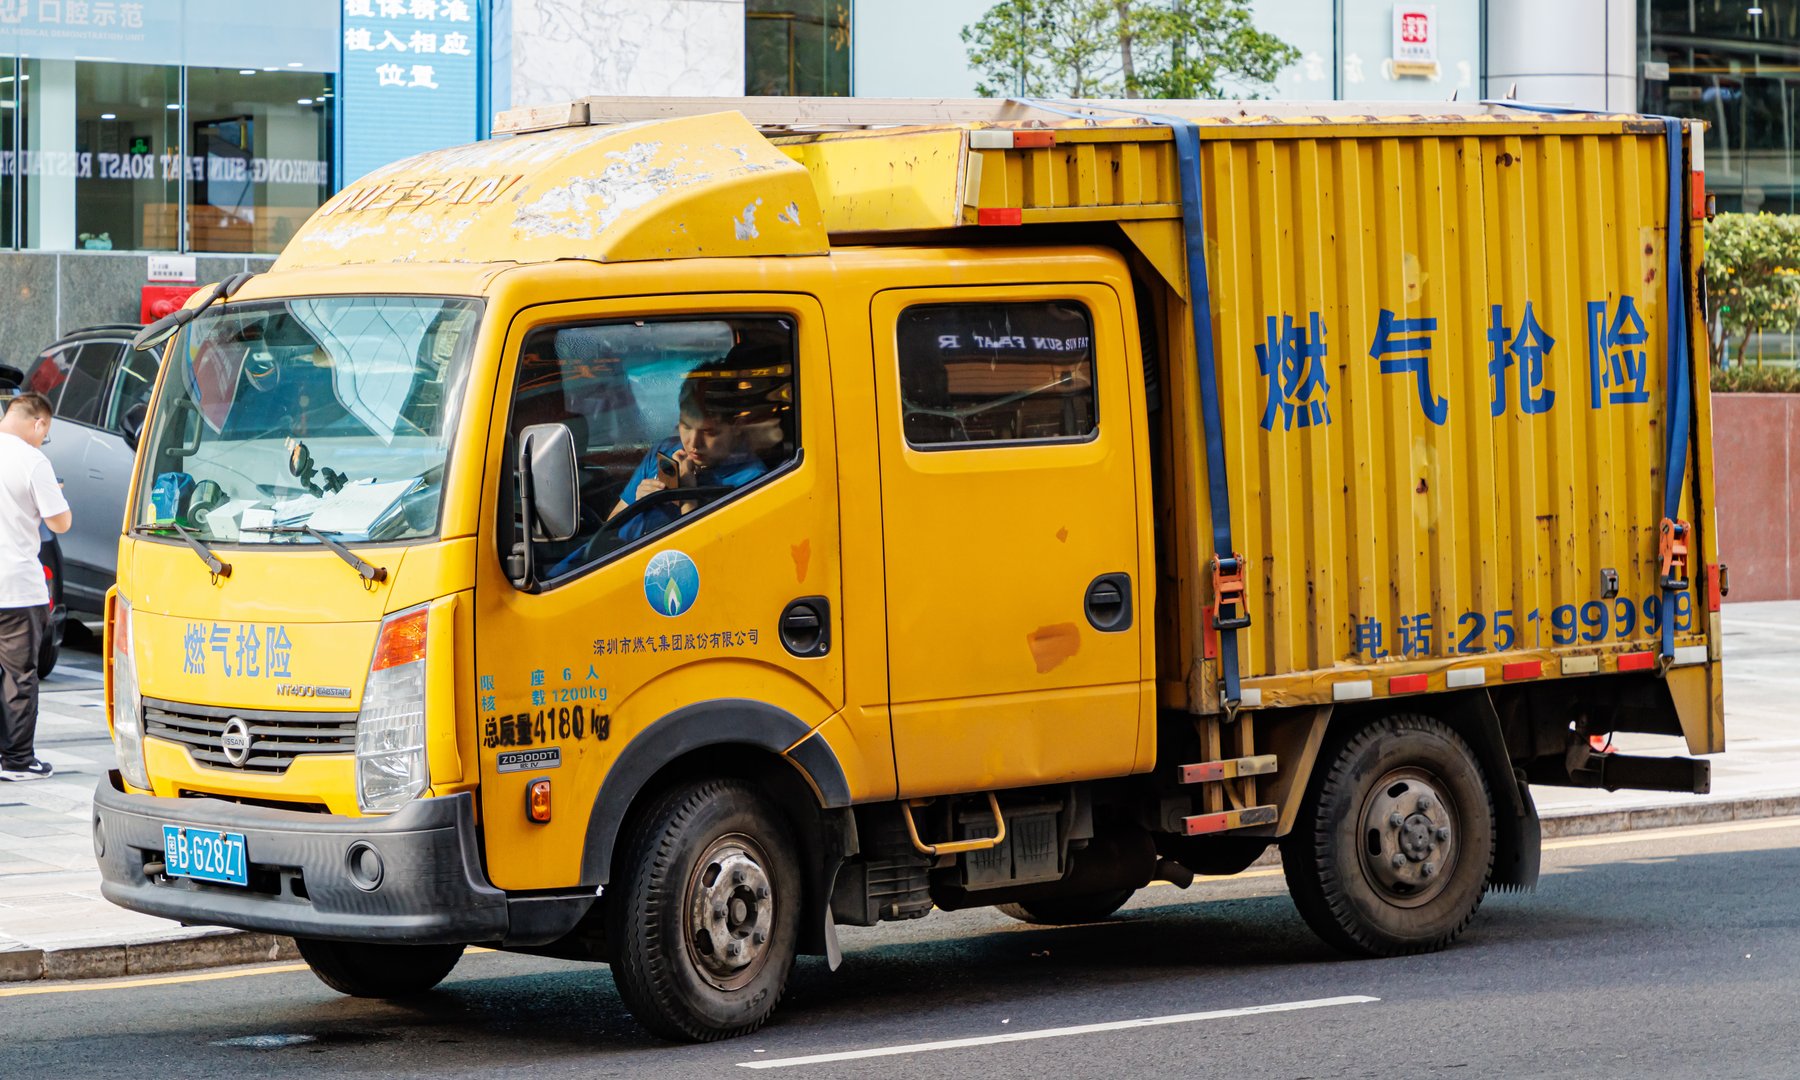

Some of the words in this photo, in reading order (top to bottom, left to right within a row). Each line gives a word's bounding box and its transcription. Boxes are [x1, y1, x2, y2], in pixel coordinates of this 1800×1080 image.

[38, 0, 144, 28] 口腔示范
[344, 28, 471, 56] 植入相应
[375, 63, 439, 89] 位置
[318, 174, 525, 217] NISSAN
[1253, 295, 1651, 433] 燃气抢险
[183, 622, 293, 679] 燃气抢险
[592, 628, 759, 656] 深圳市燃气集团股份有限公司
[276, 683, 315, 698] NT400
[479, 675, 495, 691] 限
[530, 669, 546, 687] 座
[562, 667, 572, 681] 6
[585, 663, 600, 681] 人
[480, 694, 497, 712] 核
